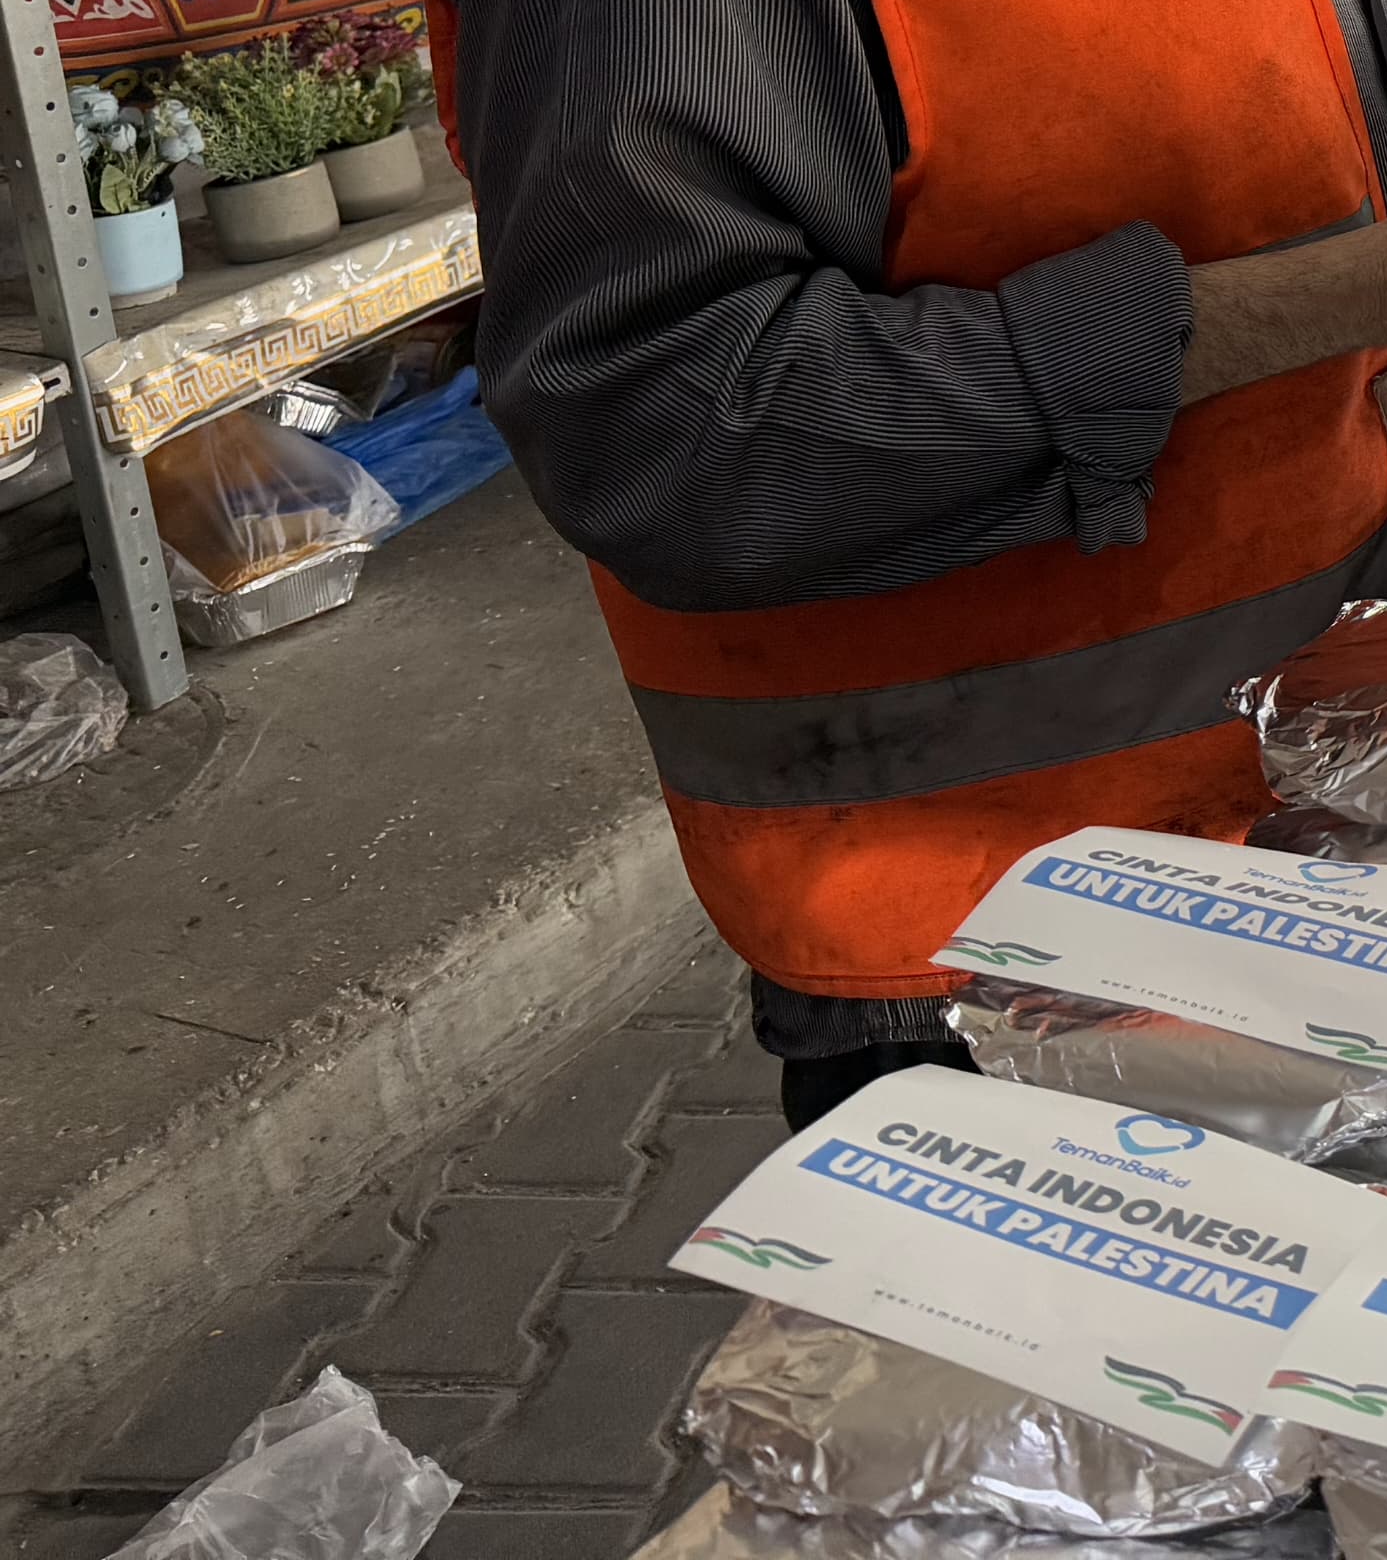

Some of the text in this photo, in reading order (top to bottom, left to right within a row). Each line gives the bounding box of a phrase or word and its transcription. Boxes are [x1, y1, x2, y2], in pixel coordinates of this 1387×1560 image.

[1047, 864, 1209, 919] UNTUK
[1088, 851, 1222, 889] CINTA
[1244, 867, 1369, 898] TemanBaik.id
[1101, 979, 1249, 1022] www.temanbaik.id
[1050, 1137, 1191, 1188] TemanBaik.id
[876, 1123, 1310, 1275] CINTA INDONESIA
[826, 1150, 1287, 1318] UNTUK PALESTINA
[874, 1288, 1042, 1352] www.temanbaik.id
